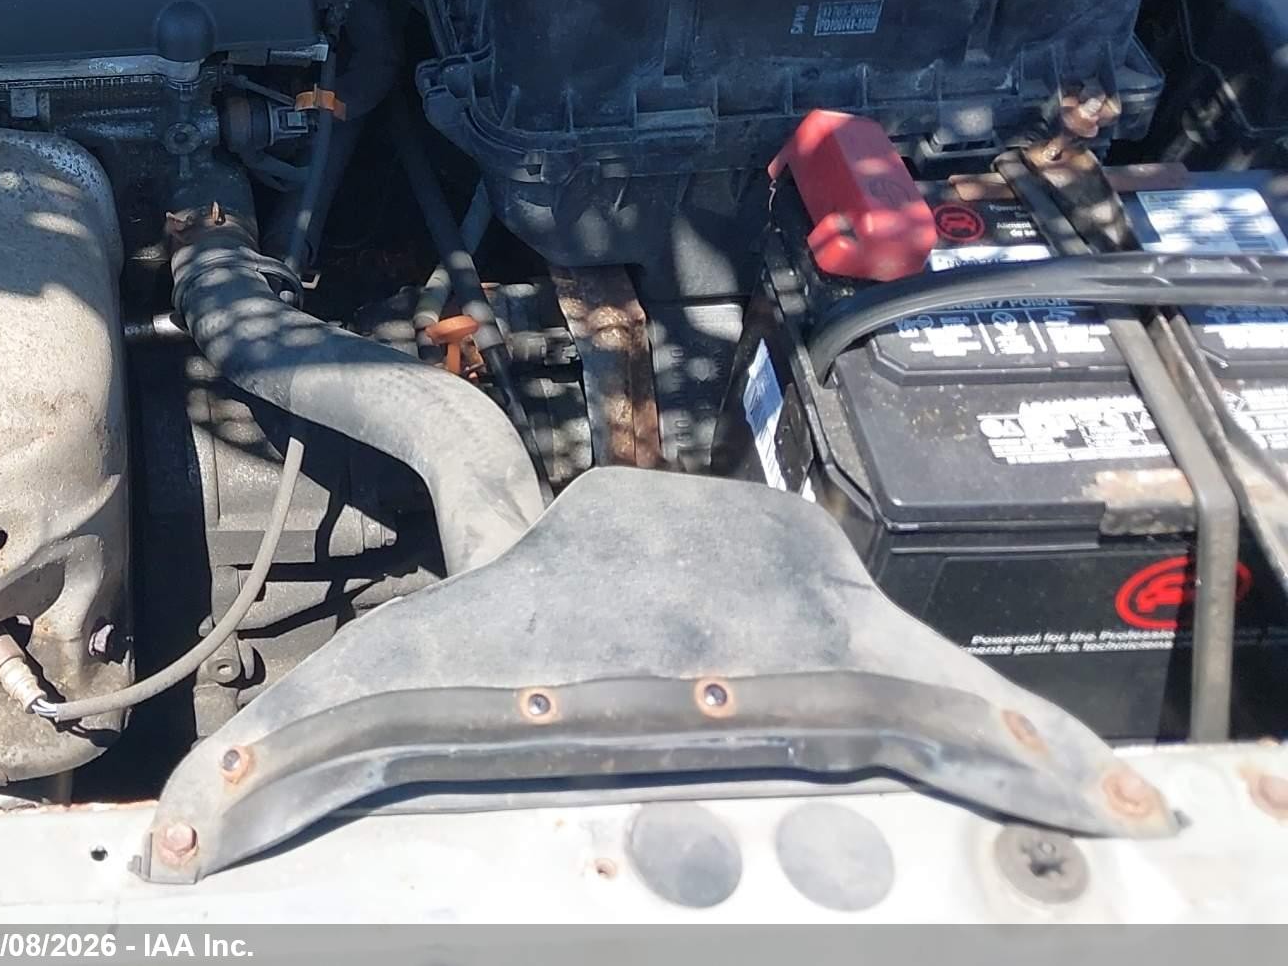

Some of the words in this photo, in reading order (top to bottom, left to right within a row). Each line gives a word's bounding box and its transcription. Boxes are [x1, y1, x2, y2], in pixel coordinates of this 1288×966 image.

[971, 633, 1041, 644] Powered
[1043, 633, 1067, 643] for
[1070, 632, 1097, 642] the
[1100, 630, 1176, 641] Professio
[1013, 644, 1051, 656] pour
